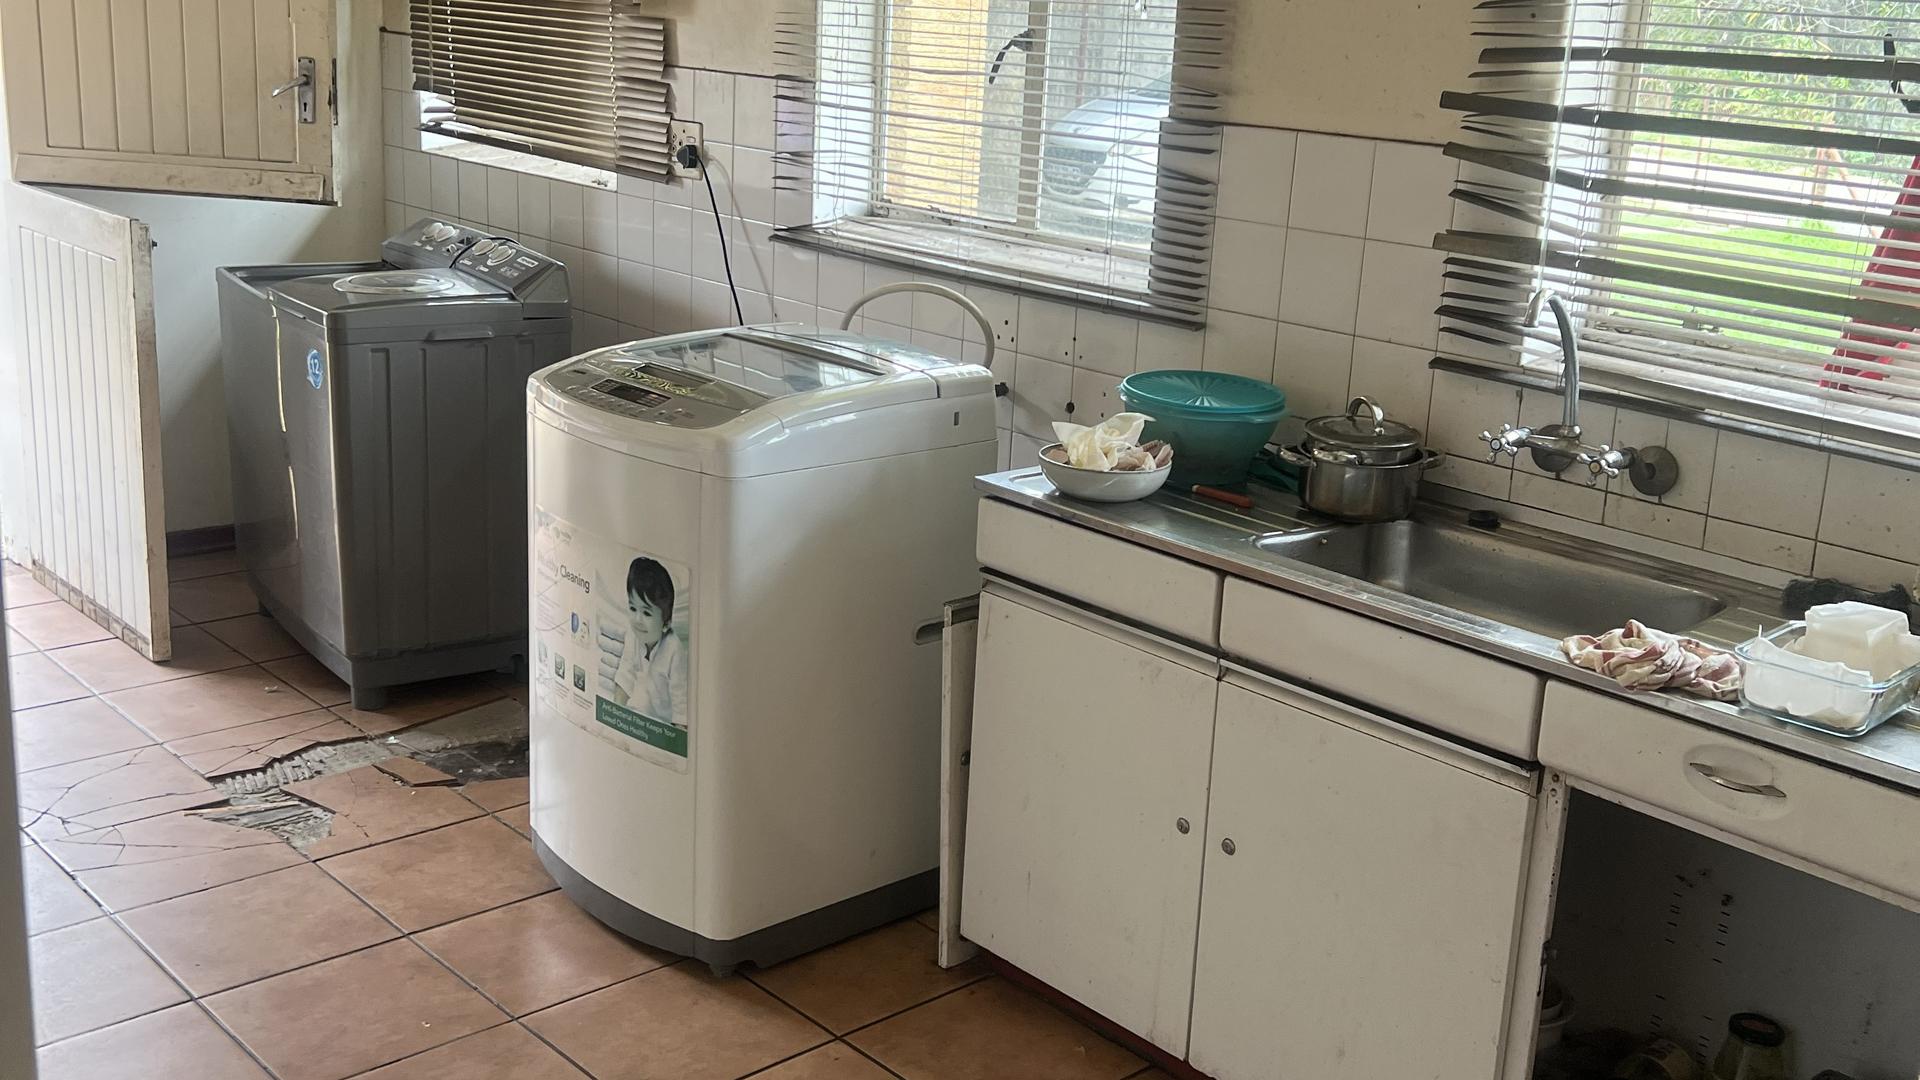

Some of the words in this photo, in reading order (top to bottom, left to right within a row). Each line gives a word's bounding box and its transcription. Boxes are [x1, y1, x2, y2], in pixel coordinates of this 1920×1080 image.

[311, 357, 319, 374] 12
[560, 564, 590, 594] Cleaning
[602, 712, 616, 725] Loved
[617, 719, 629, 731] Ones
[633, 716, 645, 726] Filter
[646, 721, 663, 735] Keeps
[664, 727, 676, 738] Your
